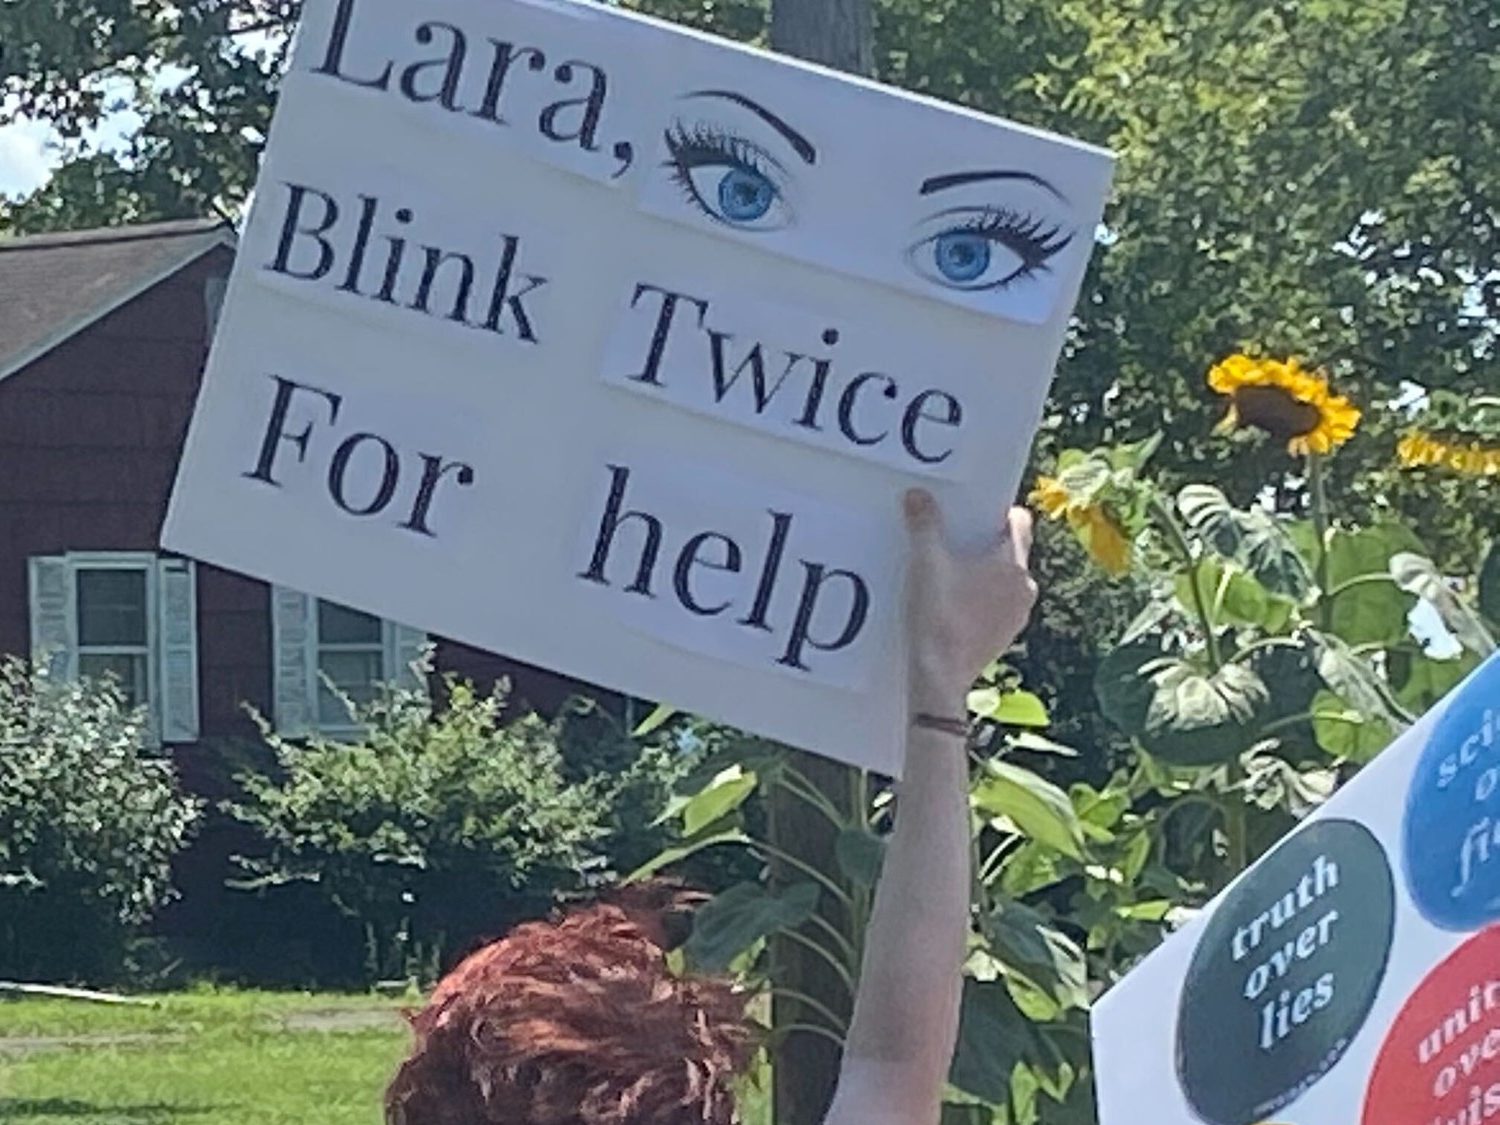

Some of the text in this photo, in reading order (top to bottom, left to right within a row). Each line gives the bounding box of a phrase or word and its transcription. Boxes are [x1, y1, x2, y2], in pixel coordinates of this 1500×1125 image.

[309, 0, 634, 178] Lara,
[263, 182, 963, 464] Blink Twice
[242, 374, 871, 673] For help
[1437, 709, 1500, 787] sci
[1232, 855, 1339, 961] truth
[1244, 909, 1339, 999] over
[1259, 972, 1335, 1049] lies
